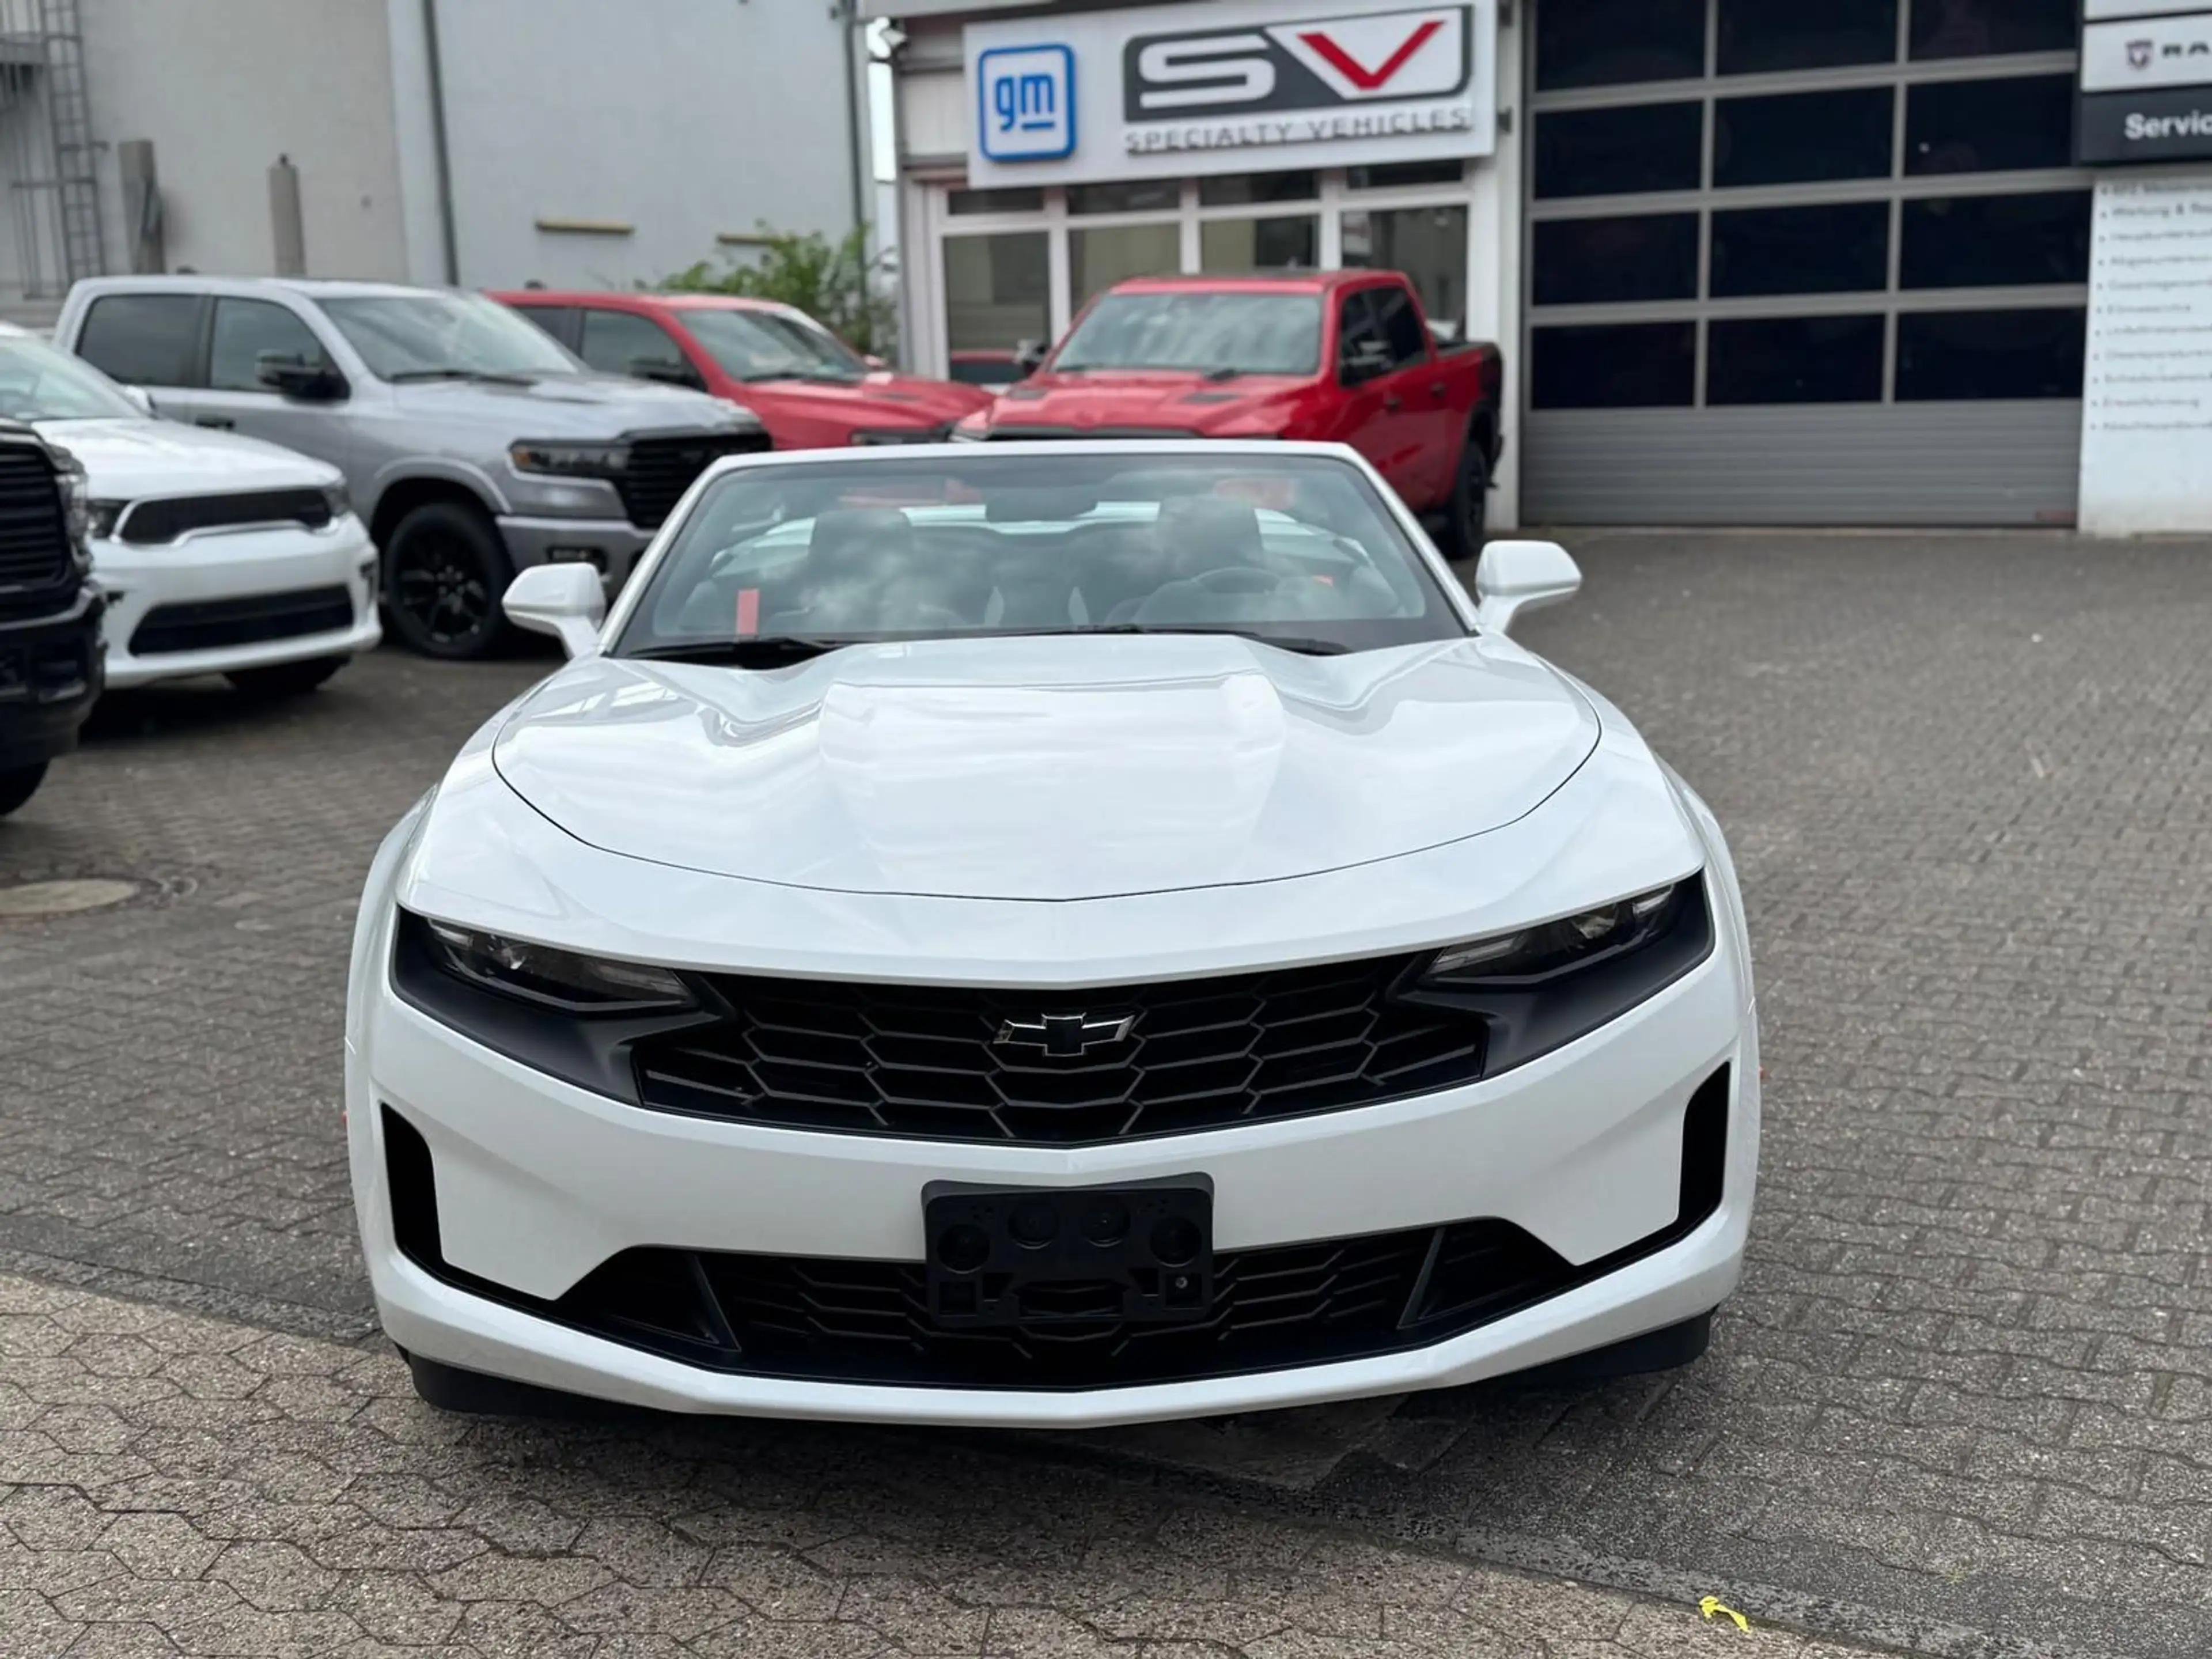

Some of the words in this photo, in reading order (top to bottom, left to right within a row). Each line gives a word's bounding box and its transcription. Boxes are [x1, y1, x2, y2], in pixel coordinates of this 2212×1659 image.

[1139, 21, 1446, 109] SV
[995, 73, 1055, 131] gm
[1125, 121, 1292, 154] SPECIALTY
[1308, 106, 1472, 140] VEHICLES
